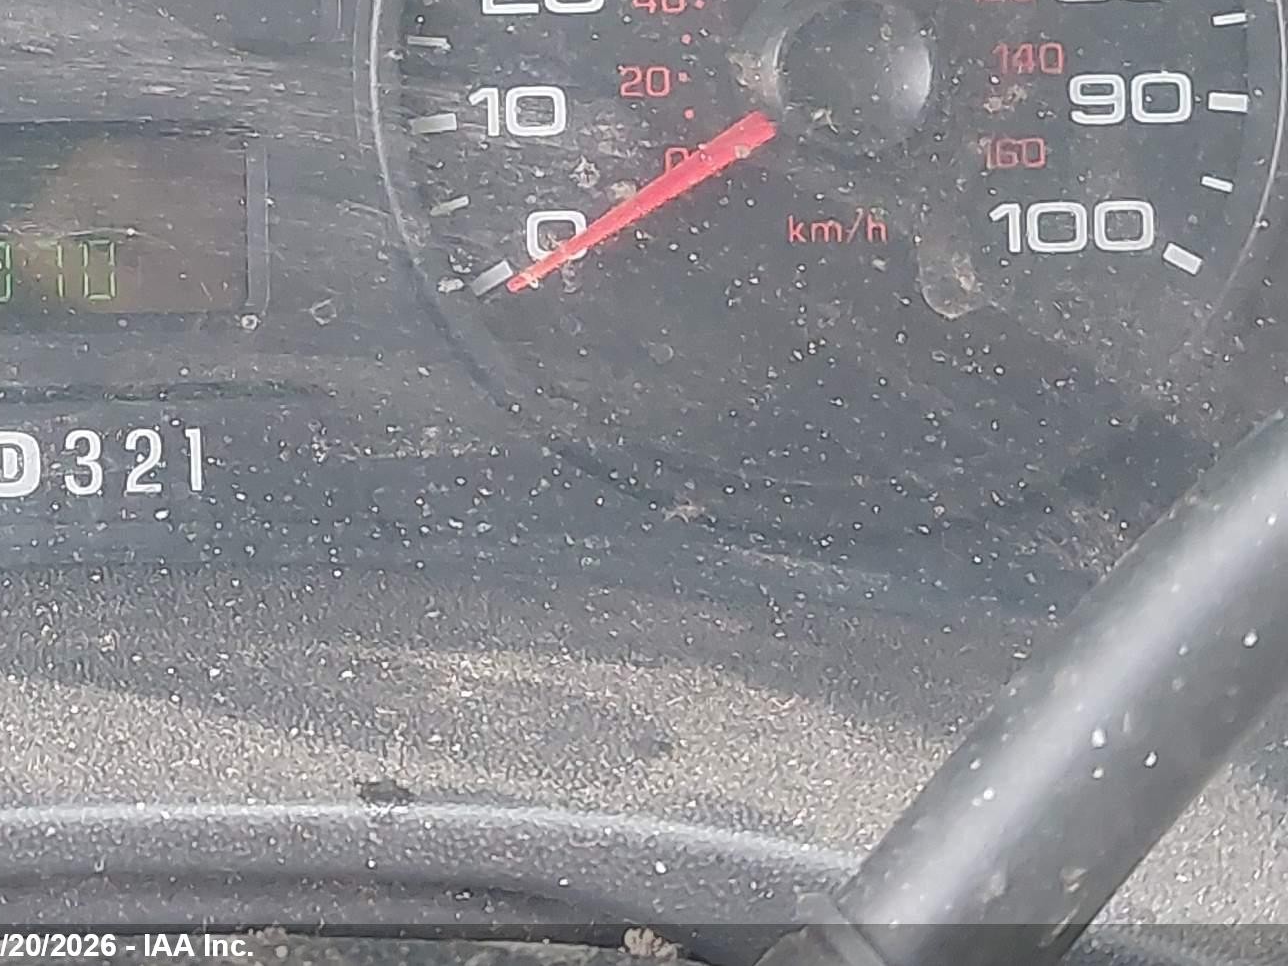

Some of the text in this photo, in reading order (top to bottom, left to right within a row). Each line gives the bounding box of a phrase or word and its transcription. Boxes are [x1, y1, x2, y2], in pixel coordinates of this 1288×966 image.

[619, 67, 670, 98] 20
[993, 43, 1065, 74] 140
[469, 86, 567, 137] 10
[1069, 72, 1192, 125] 90
[980, 137, 1046, 169] 160
[526, 210, 588, 262] 0
[788, 207, 888, 243] km/h
[989, 200, 1155, 253] 100
[64, 429, 103, 495] 3
[125, 428, 163, 494] 2
